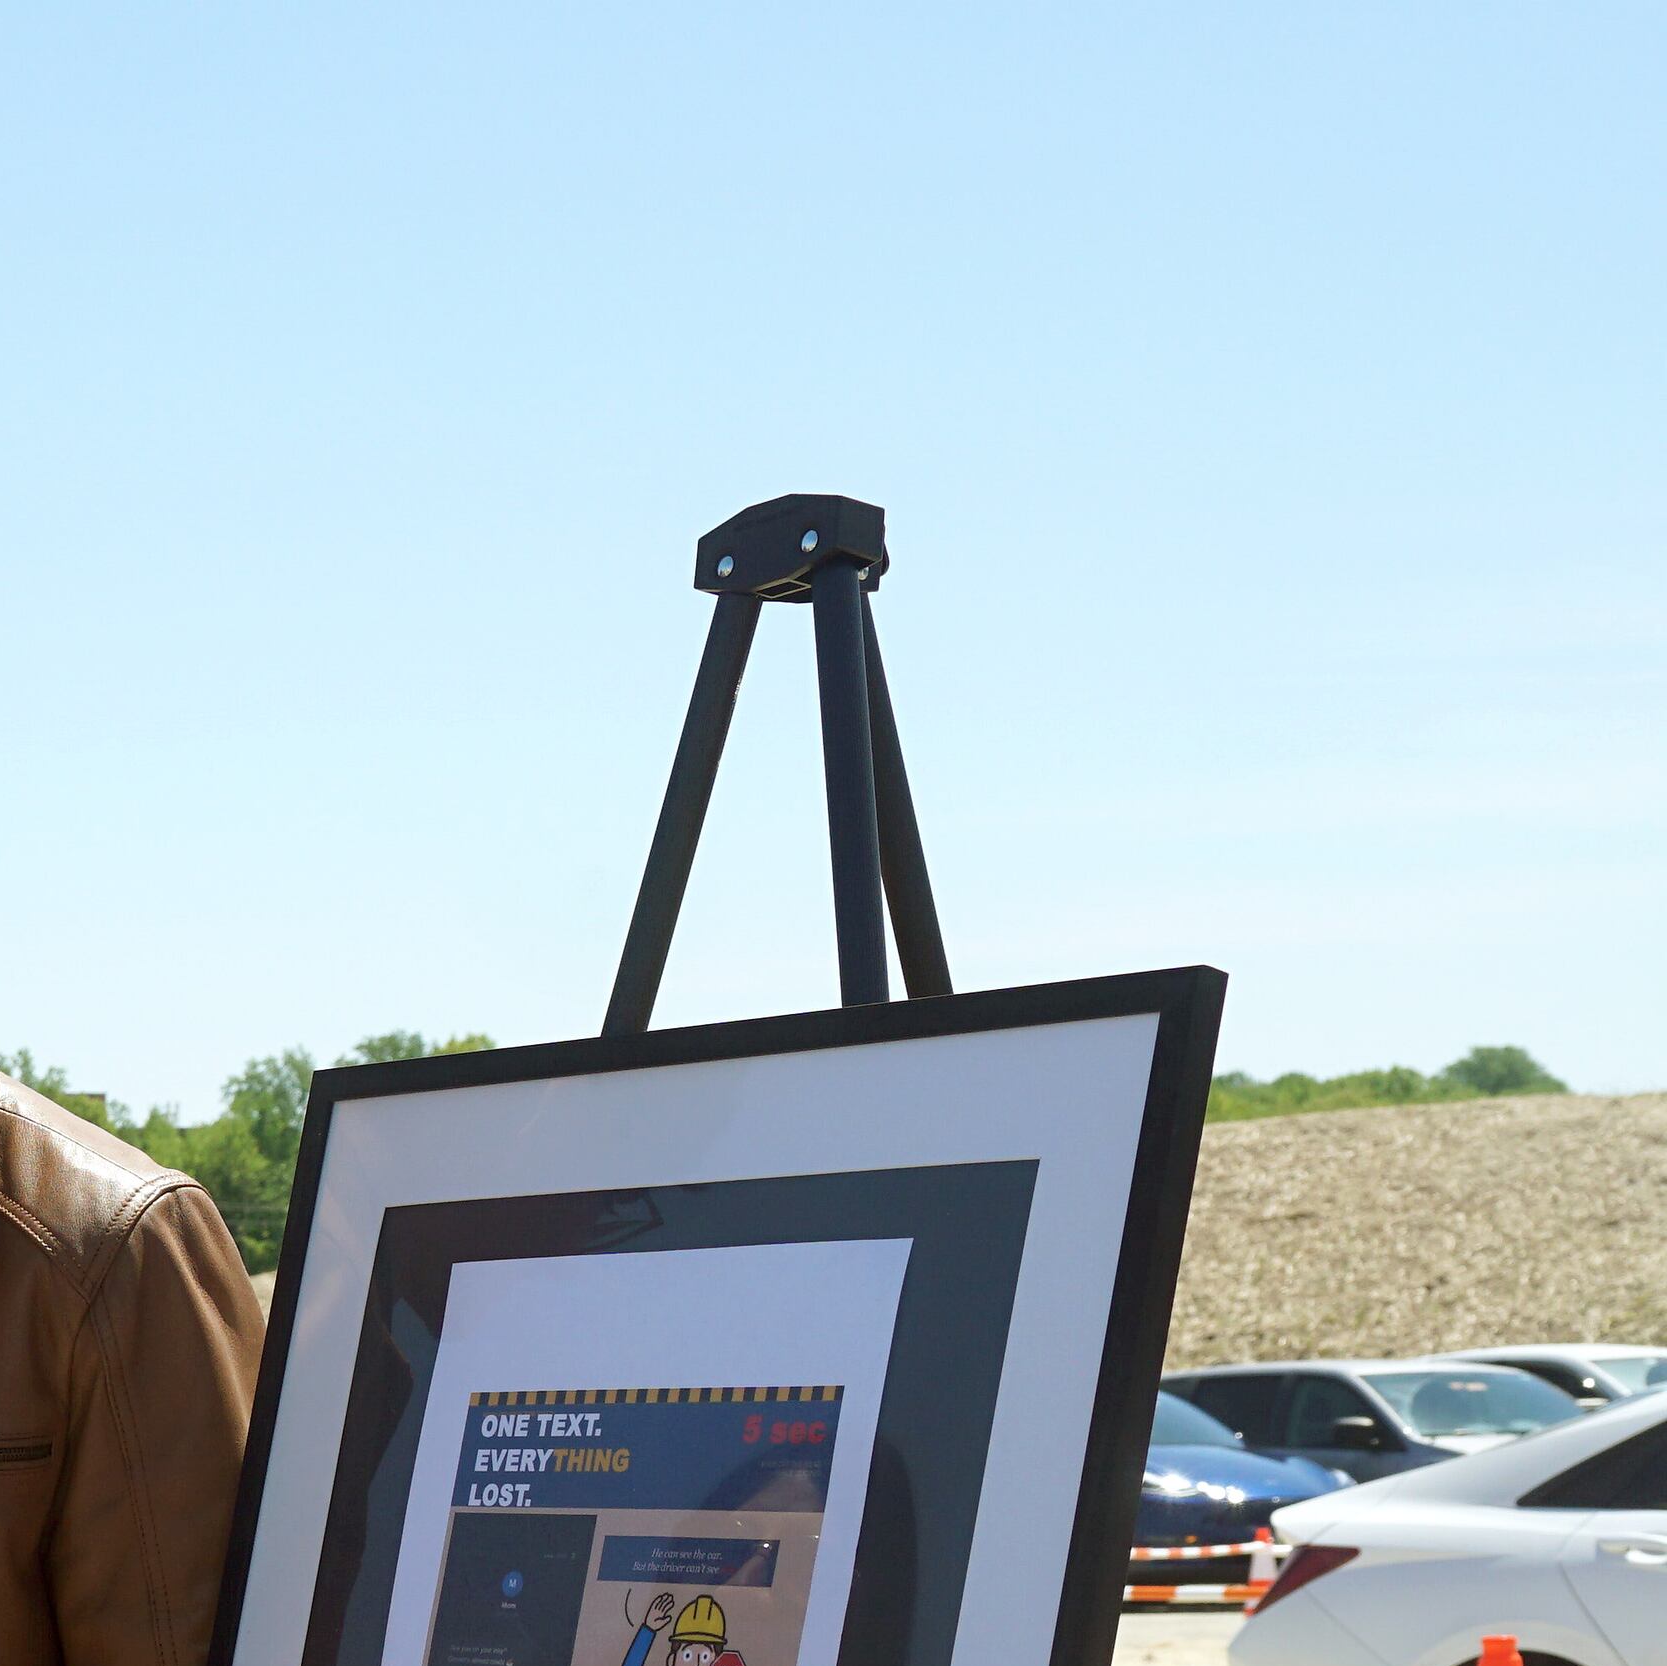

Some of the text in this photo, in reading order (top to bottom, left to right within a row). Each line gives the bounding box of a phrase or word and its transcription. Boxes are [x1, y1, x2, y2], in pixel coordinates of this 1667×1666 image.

[481, 1413, 602, 1438] ONE TEXT.
[742, 1413, 827, 1445] 5 sec
[474, 1448, 631, 1472] EVERYTHING
[468, 1483, 532, 1507] LOST.
[651, 1548, 723, 1560] He can see the car.
[633, 1561, 647, 1571] But
[647, 1562, 659, 1572] the
[660, 1563, 685, 1573] driver
[685, 1564, 705, 1574] can't
[706, 1566, 719, 1574] see
[508, 1579, 517, 1588] M
